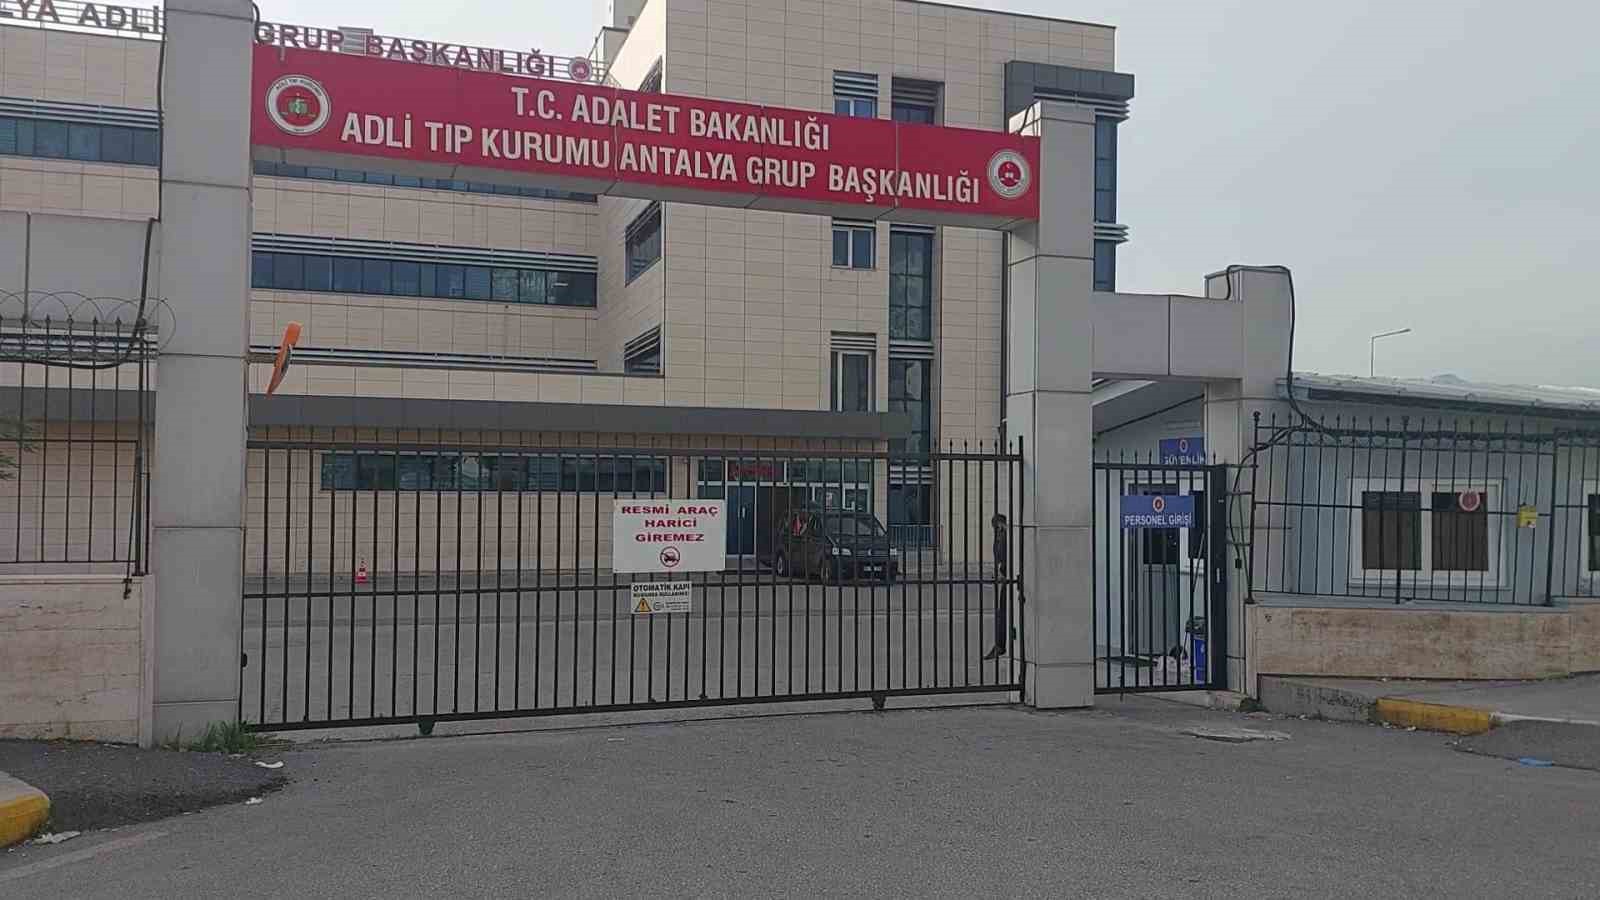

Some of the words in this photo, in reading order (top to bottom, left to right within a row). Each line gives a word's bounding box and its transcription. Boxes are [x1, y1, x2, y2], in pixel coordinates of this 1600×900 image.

[255, 22, 345, 52] GRUP
[511, 86, 562, 120] T.C.
[571, 94, 680, 134] ADALET
[690, 108, 829, 151] BAKANLIĞI
[340, 111, 412, 149] ADLİ
[424, 120, 473, 154] TIP
[481, 127, 610, 169] KURUMU
[619, 142, 738, 182] ANTALYA
[746, 156, 816, 189] GRUP
[828, 163, 980, 204] BAŞKANLIĞI
[622, 504, 669, 514] RESMİ
[677, 505, 719, 517] ARAÇ
[645, 517, 697, 528] HARİCİ
[1124, 513, 1167, 526] PERSONEL
[1168, 512, 1192, 528] GİRİŞİ
[635, 531, 705, 543] GİREMEZ
[633, 583, 672, 592] OTOMATİK
